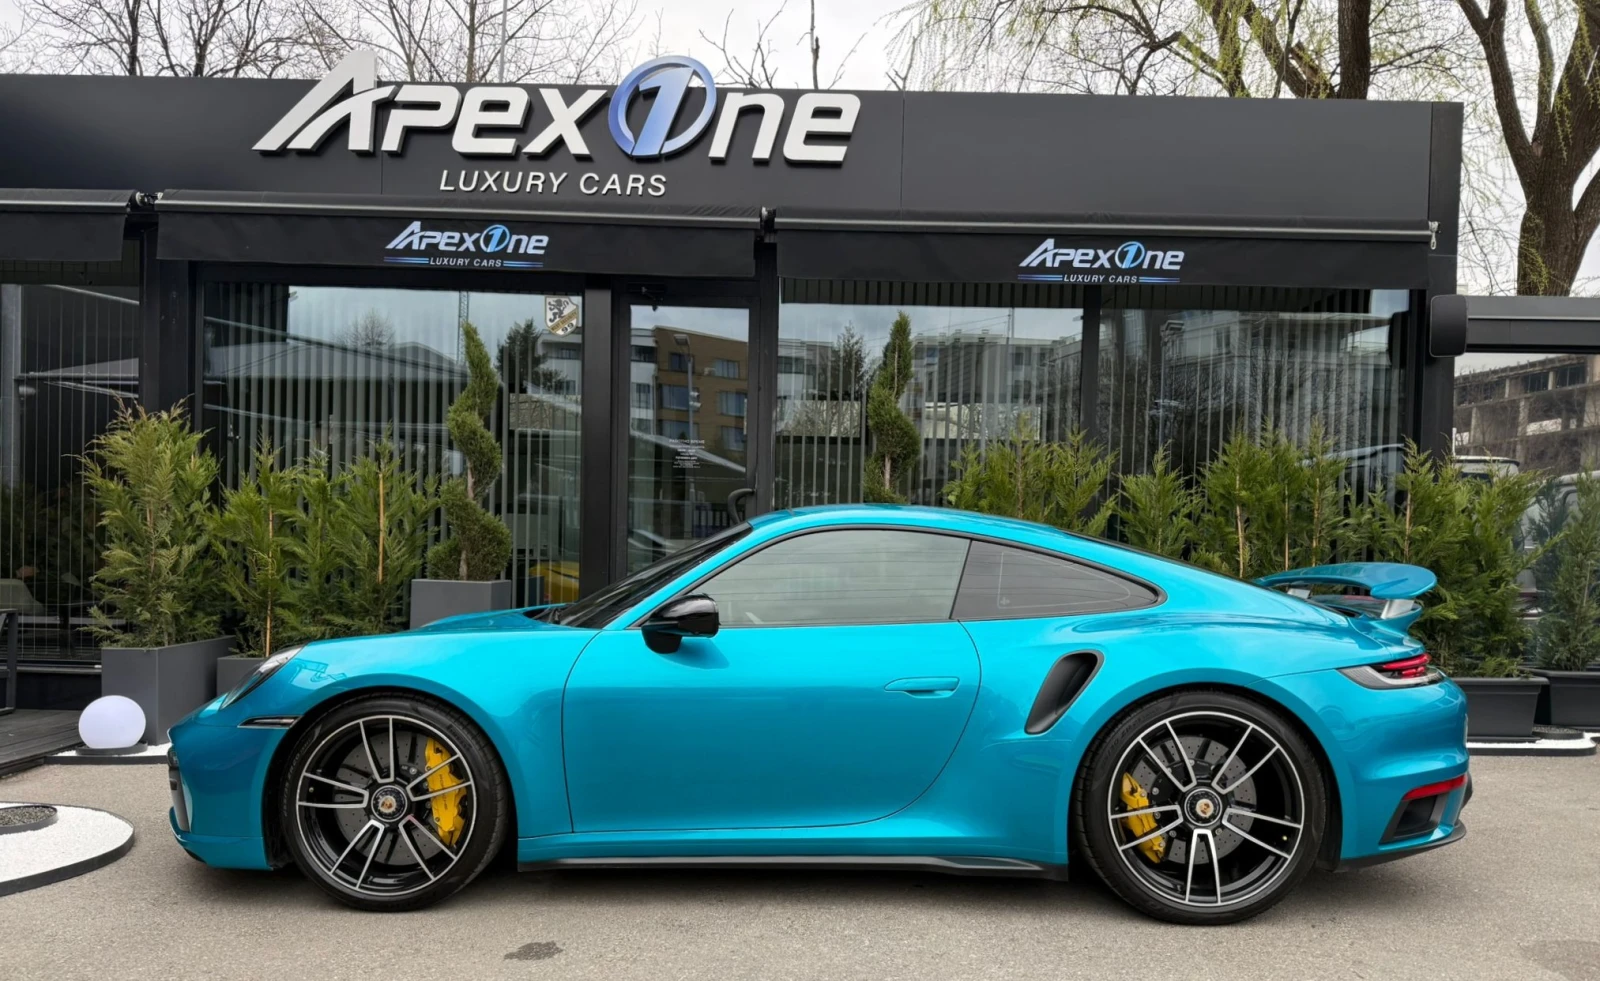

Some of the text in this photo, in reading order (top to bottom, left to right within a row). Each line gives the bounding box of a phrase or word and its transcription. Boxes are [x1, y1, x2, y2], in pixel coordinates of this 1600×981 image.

[440, 170, 667, 196] LUXURY CARS
[430, 257, 502, 268] LUXURY CARS
[1063, 274, 1137, 284] LUXURY CARS
